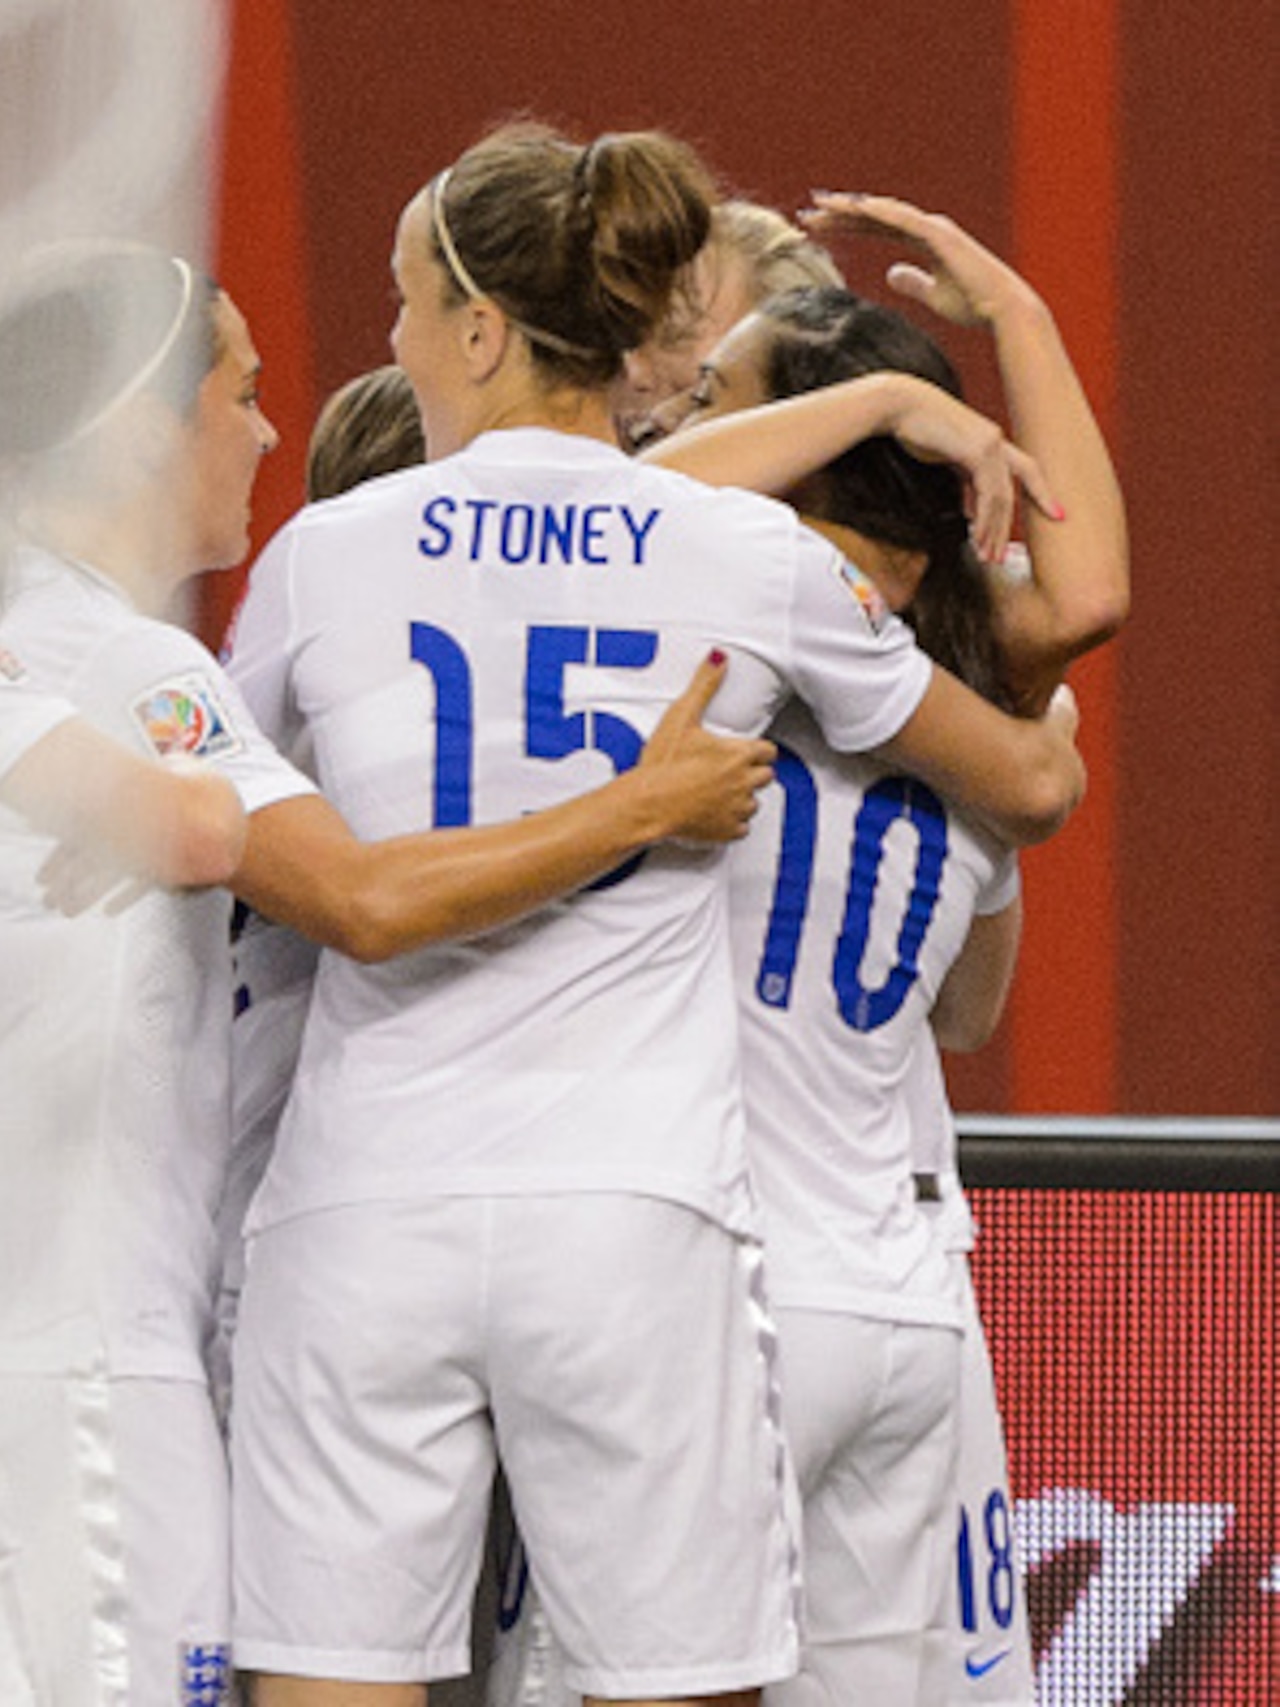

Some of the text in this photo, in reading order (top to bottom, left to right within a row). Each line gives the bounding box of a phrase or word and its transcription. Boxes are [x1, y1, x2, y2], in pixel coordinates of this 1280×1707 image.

[418, 496, 663, 567] STONEY
[410, 621, 659, 891] 15
[757, 743, 948, 1033] 10
[957, 1488, 1014, 1634] 18
